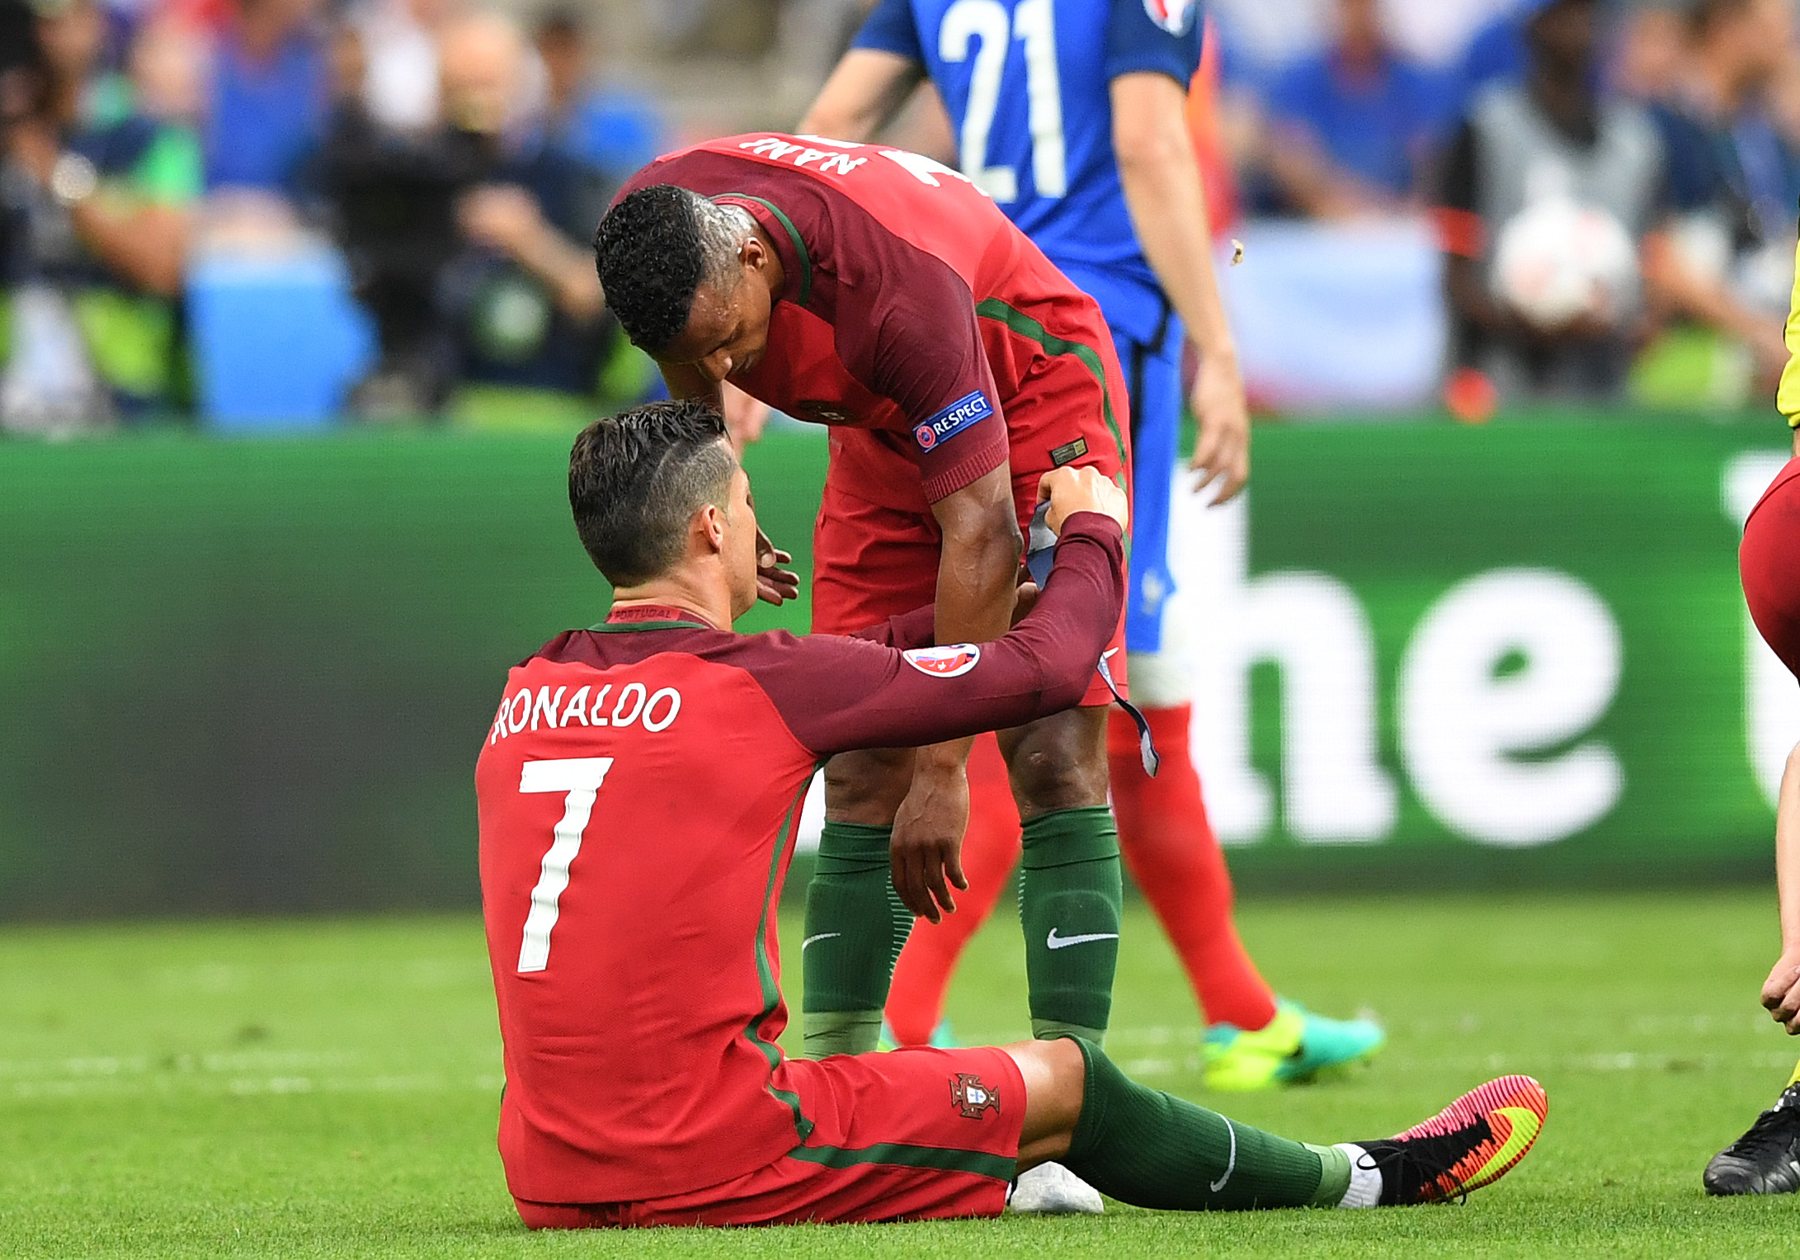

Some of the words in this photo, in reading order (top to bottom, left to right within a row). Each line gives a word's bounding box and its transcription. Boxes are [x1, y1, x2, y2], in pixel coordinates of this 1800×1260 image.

[938, 0, 1067, 203] 21
[738, 137, 868, 175] NANI
[934, 396, 988, 435] RESPECT
[614, 608, 672, 619] PORTUGAL
[1166, 456, 1625, 847] he
[491, 682, 681, 744] RONALDO
[518, 758, 613, 973] 7
